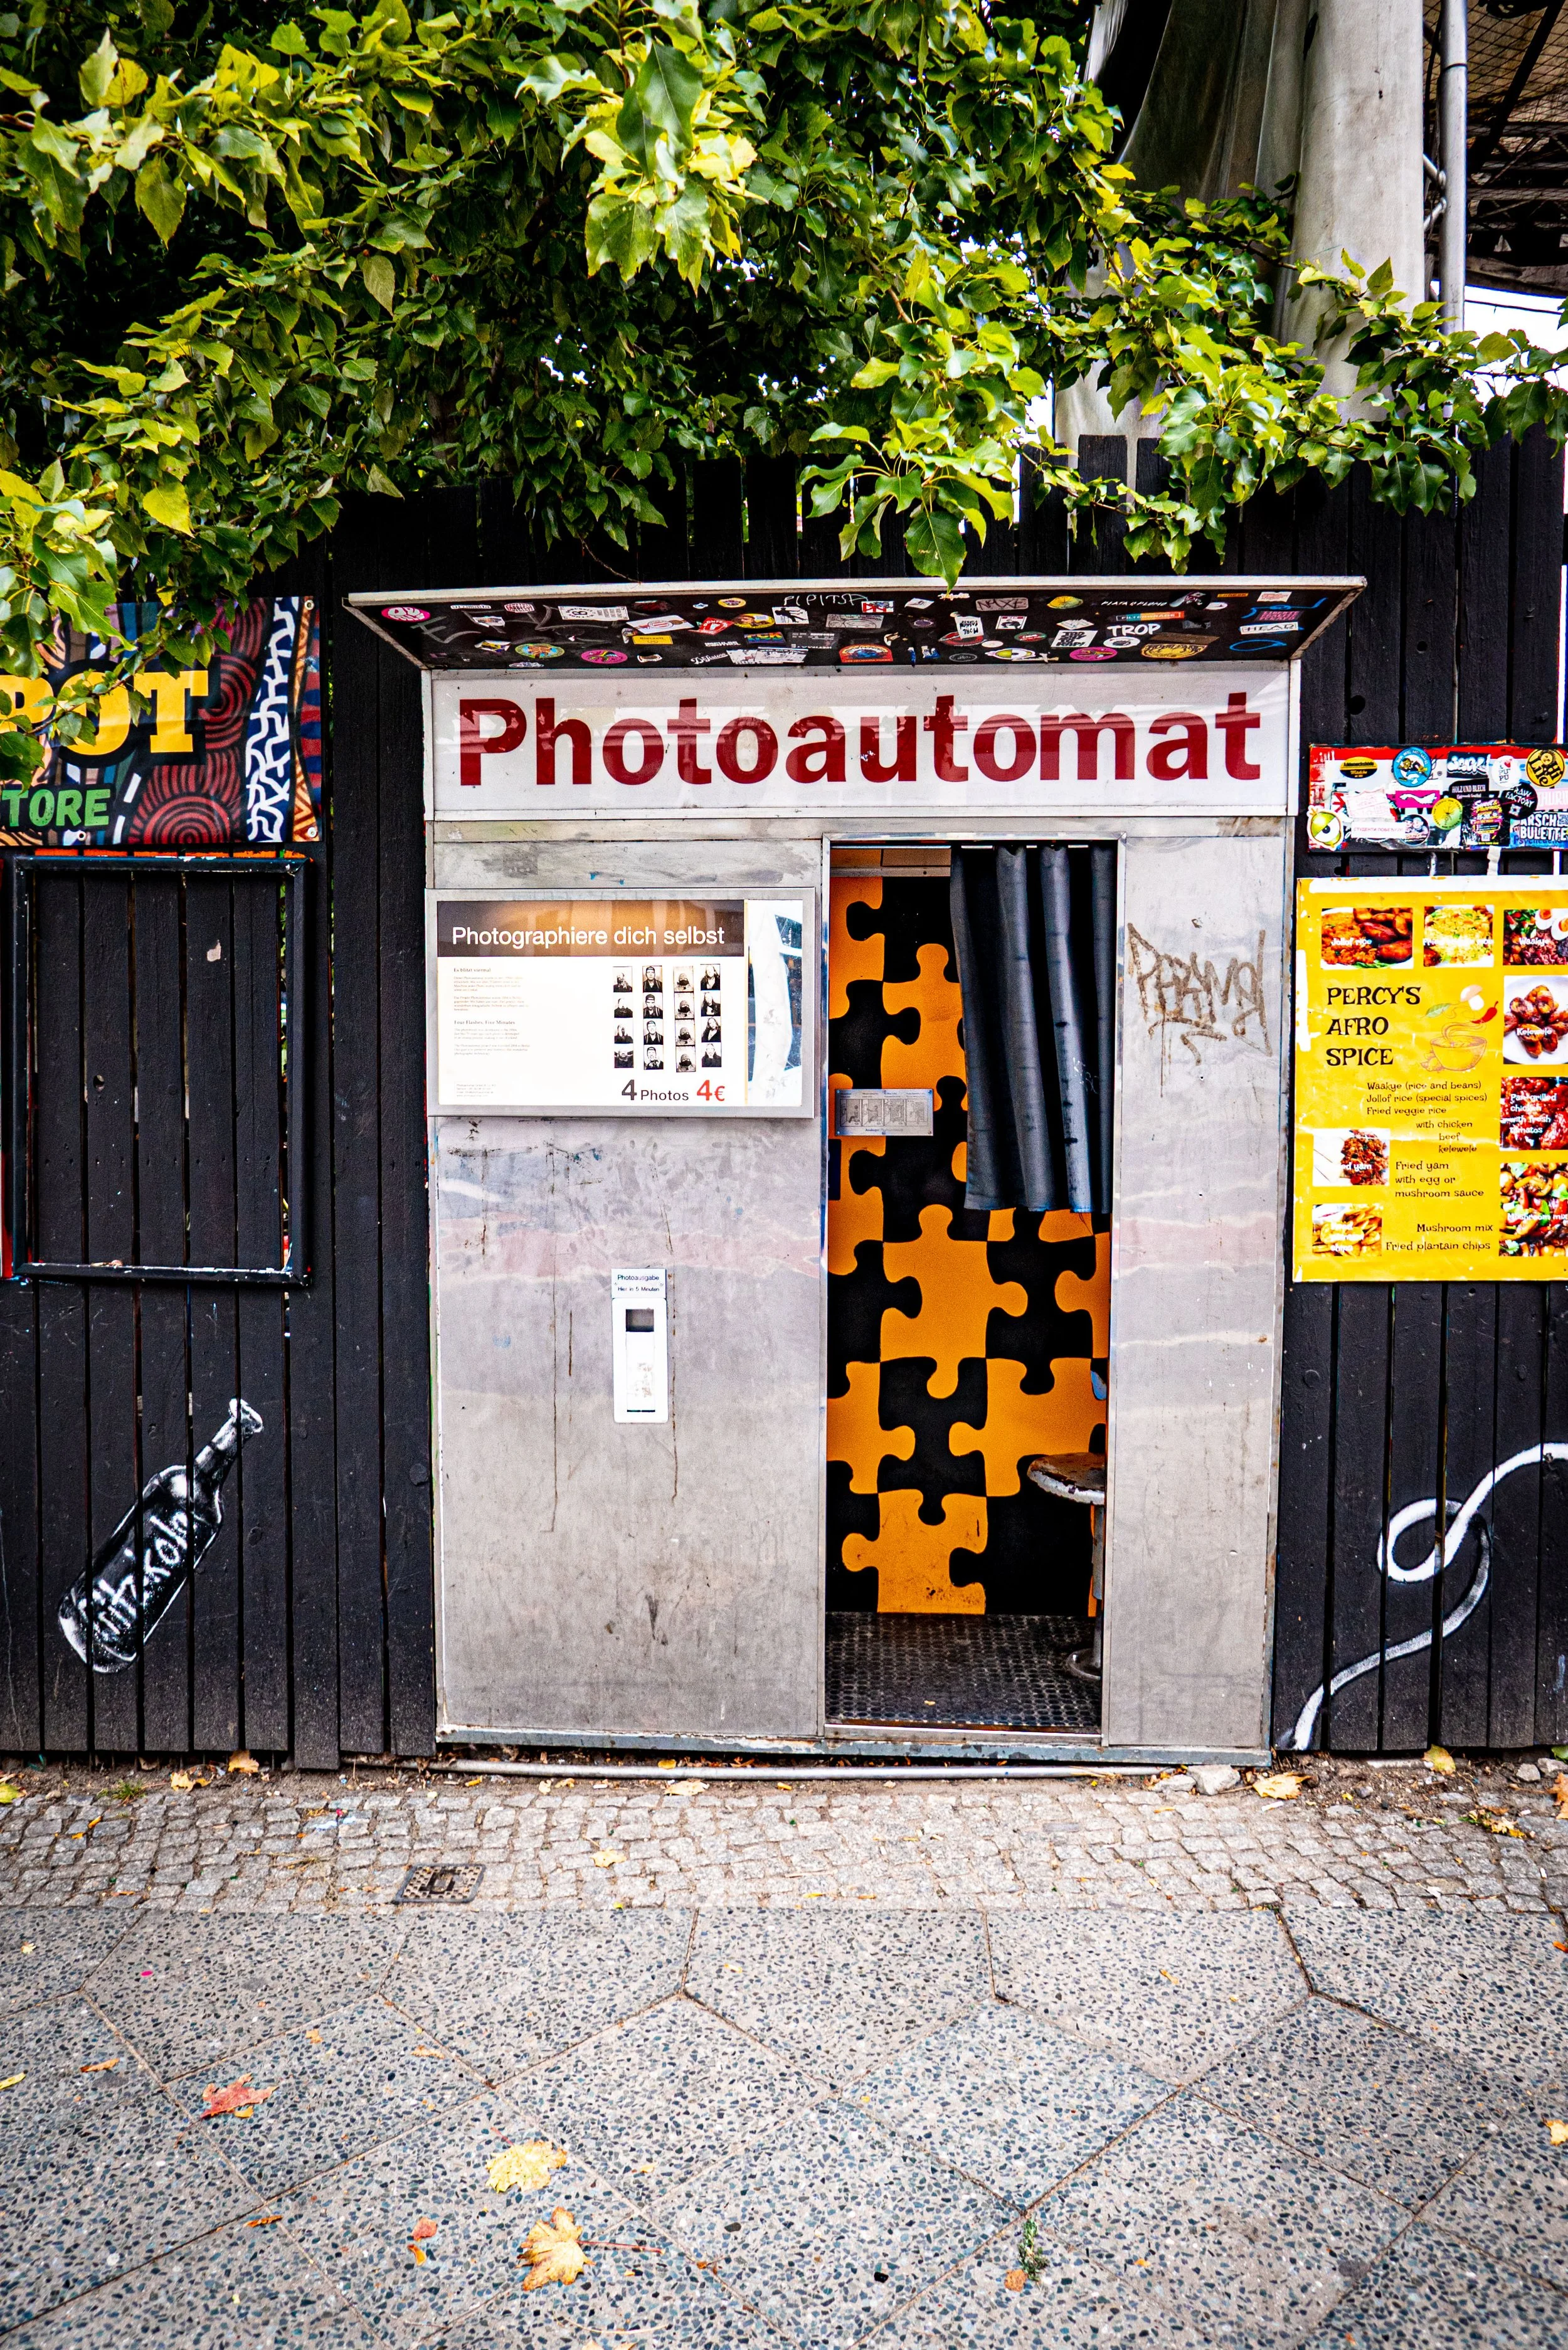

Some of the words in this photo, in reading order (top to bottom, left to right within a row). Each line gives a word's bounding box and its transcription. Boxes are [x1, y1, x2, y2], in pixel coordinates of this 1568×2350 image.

[1106, 623, 1161, 637] TROP
[1244, 623, 1294, 632] HEAD
[459, 692, 1261, 786] Photoautomat
[1505, 791, 1535, 808] FACTORY
[1520, 826, 1567, 841] BULETTE
[452, 926, 608, 949] Photographiere
[613, 926, 657, 945] dich
[664, 926, 725, 945] selbst
[1330, 937, 1353, 946] Jollof
[1355, 938, 1372, 946] rice
[1327, 985, 1421, 1005] PERCY'S
[1325, 1016, 1389, 1035] AFRO
[1326, 1047, 1394, 1066] SPICE
[621, 1079, 637, 1101] 4
[640, 1088, 689, 1101] Photos
[696, 1079, 725, 1102] 4€
[1367, 1082, 1402, 1092] Waakye
[1430, 1081, 1448, 1089] and
[1451, 1080, 1482, 1090] beans)
[1366, 1094, 1392, 1103] Jollof
[1416, 1093, 1452, 1104] (special
[1454, 1093, 1488, 1103] spices)
[1367, 1106, 1391, 1115] Fried
[1394, 1107, 1426, 1116] veggie
[1416, 1120, 1434, 1128] with
[1437, 1120, 1473, 1128] chicken
[1439, 1133, 1461, 1141] beef
[1438, 1145, 1478, 1153] kelewele
[1396, 1160, 1423, 1170] Fried
[1426, 1162, 1449, 1172] yam
[1395, 1175, 1416, 1183] with
[1419, 1177, 1440, 1185] egg
[1444, 1176, 1456, 1184] or
[1395, 1189, 1451, 1197] mushroom
[1416, 1223, 1471, 1232] Mushroom
[1475, 1223, 1493, 1232] mix
[1386, 1241, 1413, 1251] Fried
[1417, 1241, 1459, 1251] plantain
[1463, 1241, 1491, 1251] chips
